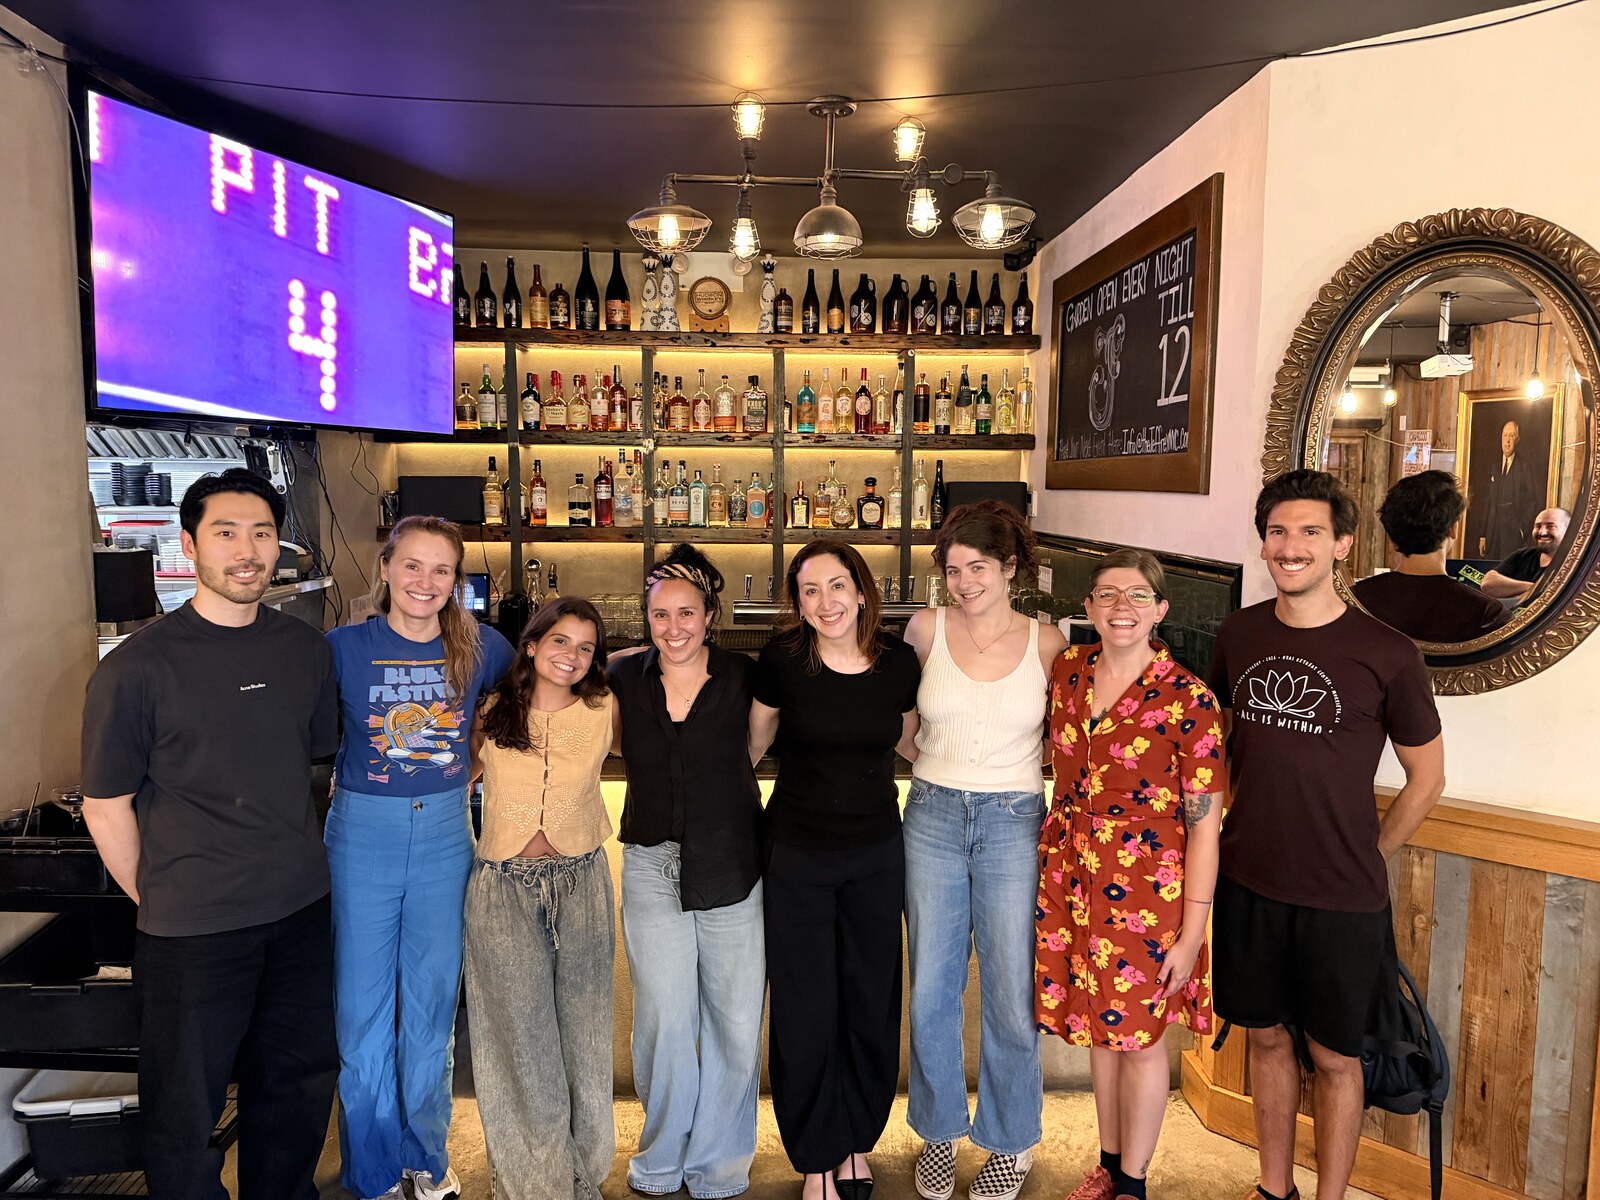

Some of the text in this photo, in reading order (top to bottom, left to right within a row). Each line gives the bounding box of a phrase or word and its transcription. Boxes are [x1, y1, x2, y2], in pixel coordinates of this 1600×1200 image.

[211, 132, 338, 255] PIT
[1065, 236, 1193, 333] GARDEN OPEN EVERY NIGHT
[1158, 276, 1194, 327] TILL
[288, 279, 337, 411] 4
[1156, 324, 1190, 407] 12
[1295, 657, 1318, 671] RETREAT
[1315, 667, 1332, 686] CENTER
[1240, 709, 1323, 735] ALL IS WITHIN
